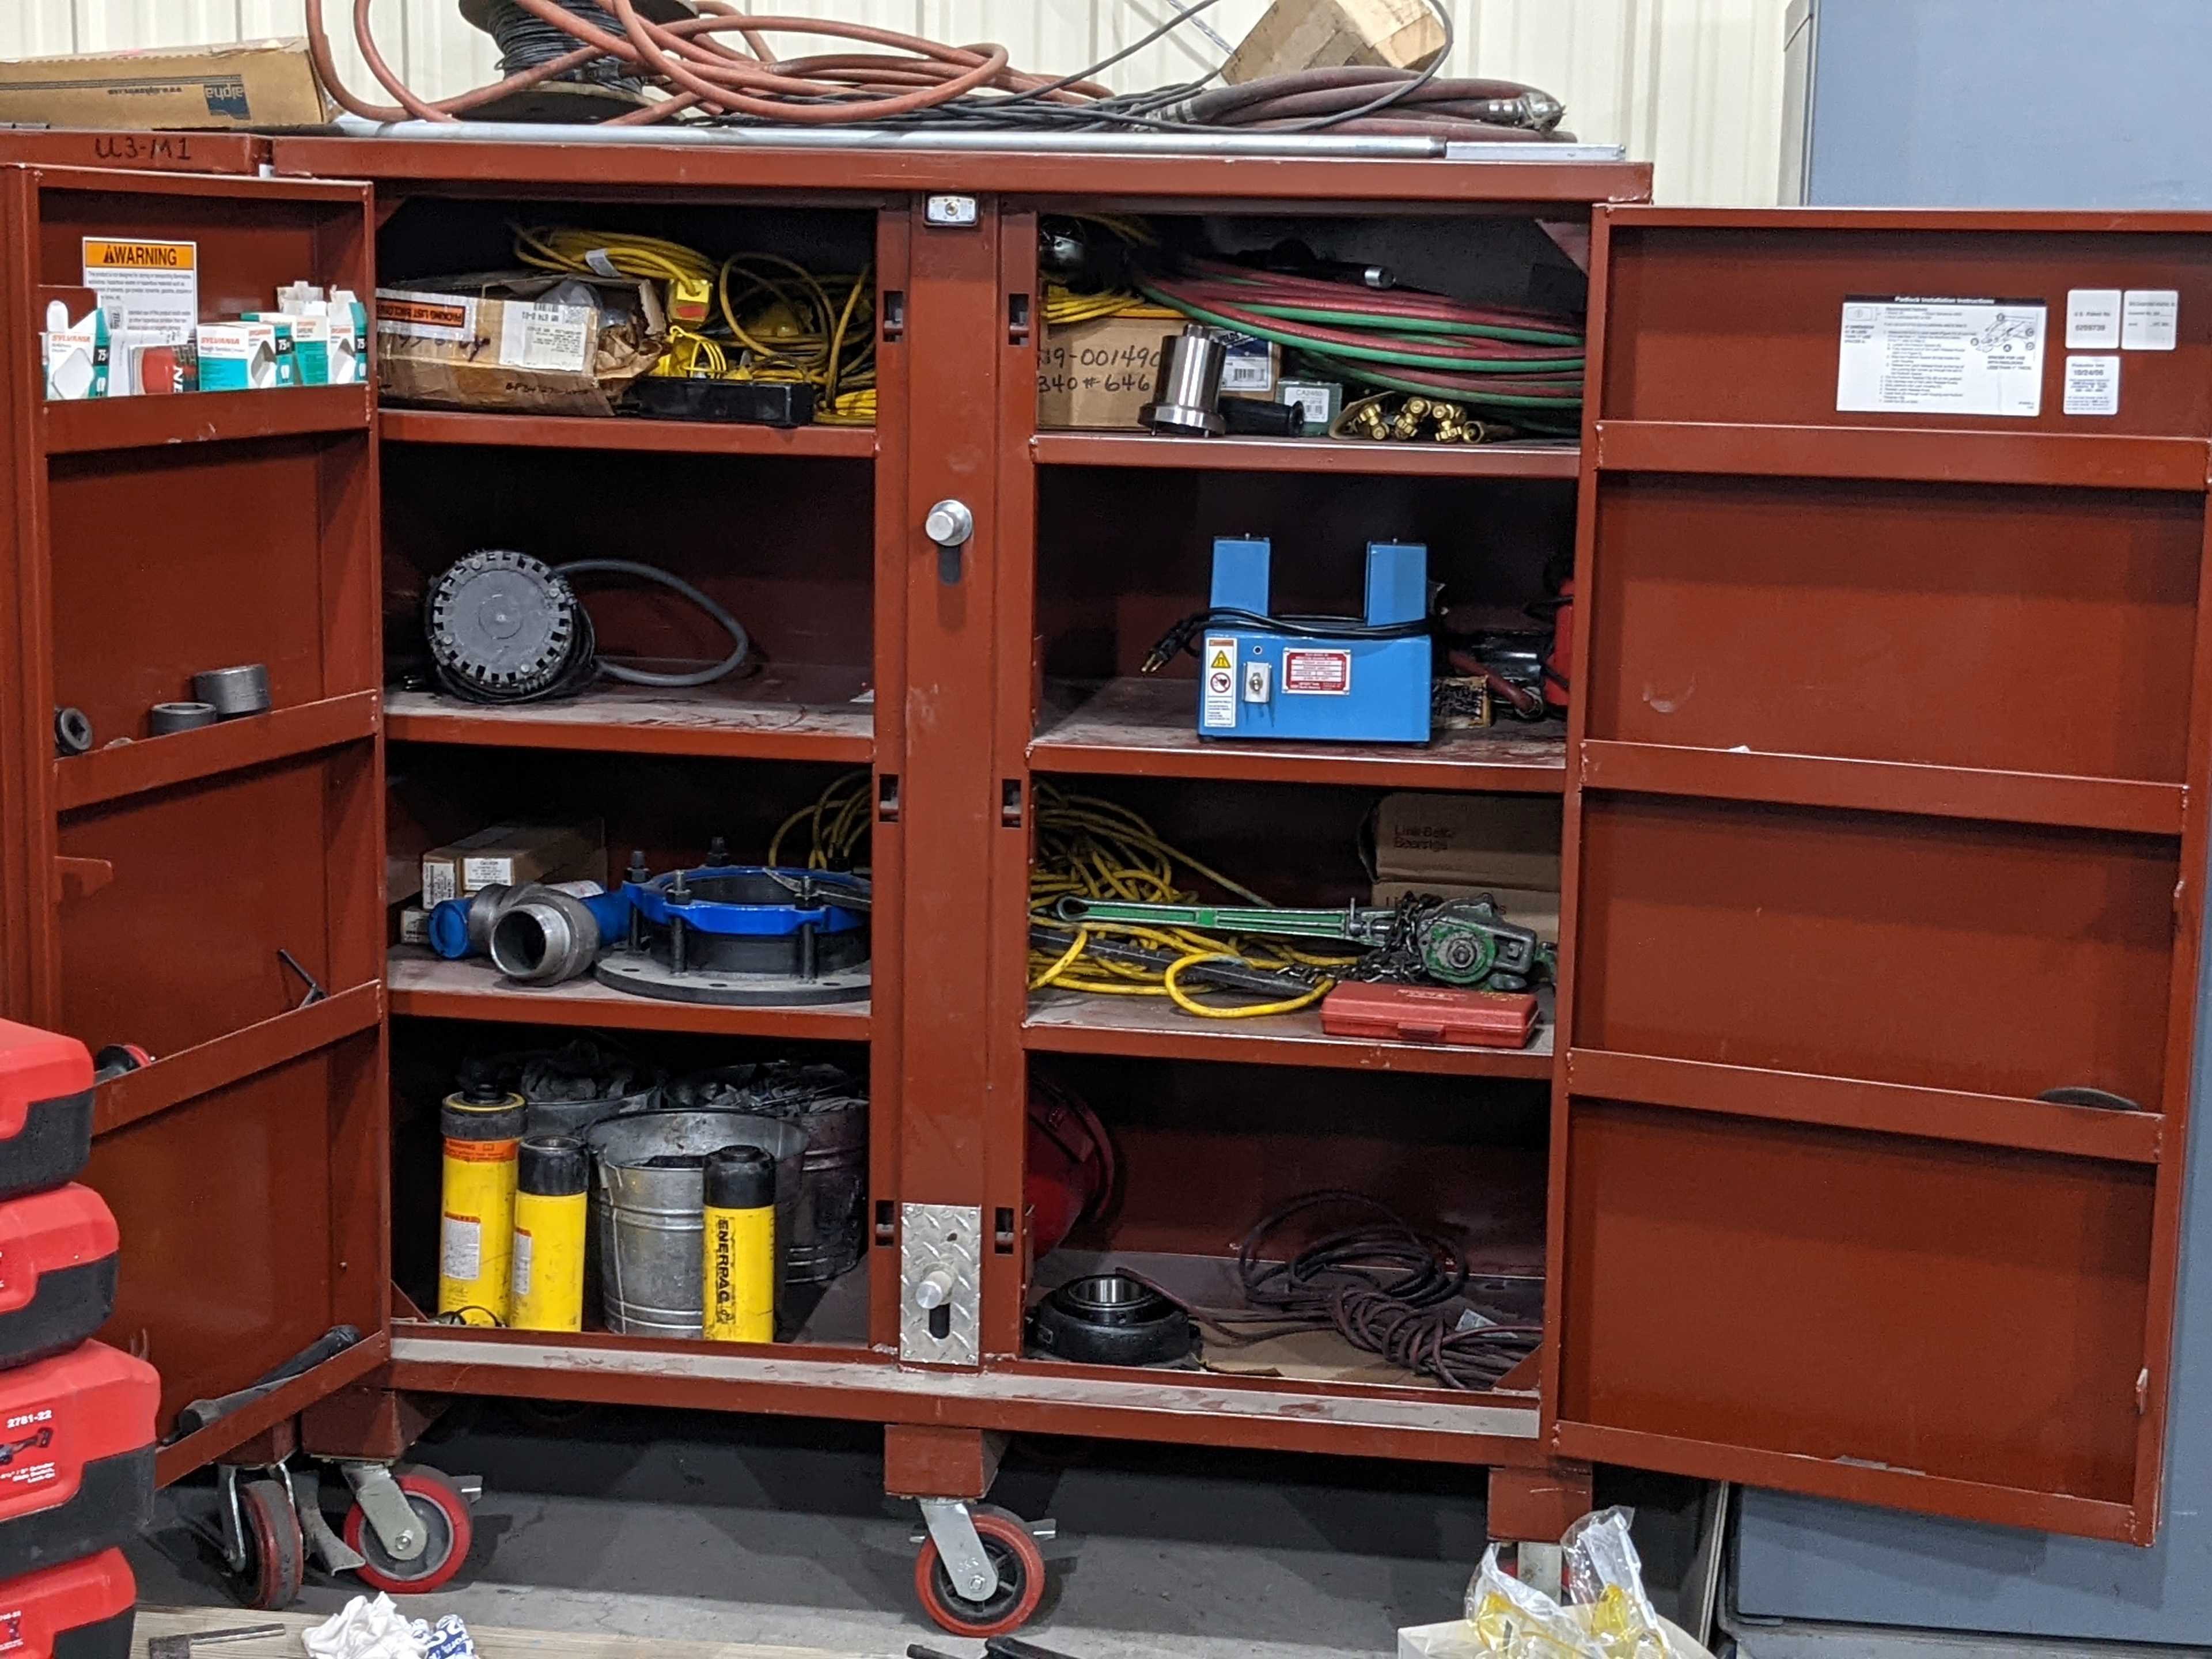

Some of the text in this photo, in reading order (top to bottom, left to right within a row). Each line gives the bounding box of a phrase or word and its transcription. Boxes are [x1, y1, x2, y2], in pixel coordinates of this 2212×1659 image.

[206, 85, 244, 100] alpha
[114, 246, 177, 266] WARNING
[412, 308, 429, 319] LIST
[52, 335, 91, 343] SYLVANIA
[201, 337, 240, 345] SYLVANIA
[717, 1218, 730, 1304] ENERPAC
[7, 1410, 52, 1429] 2781-22
